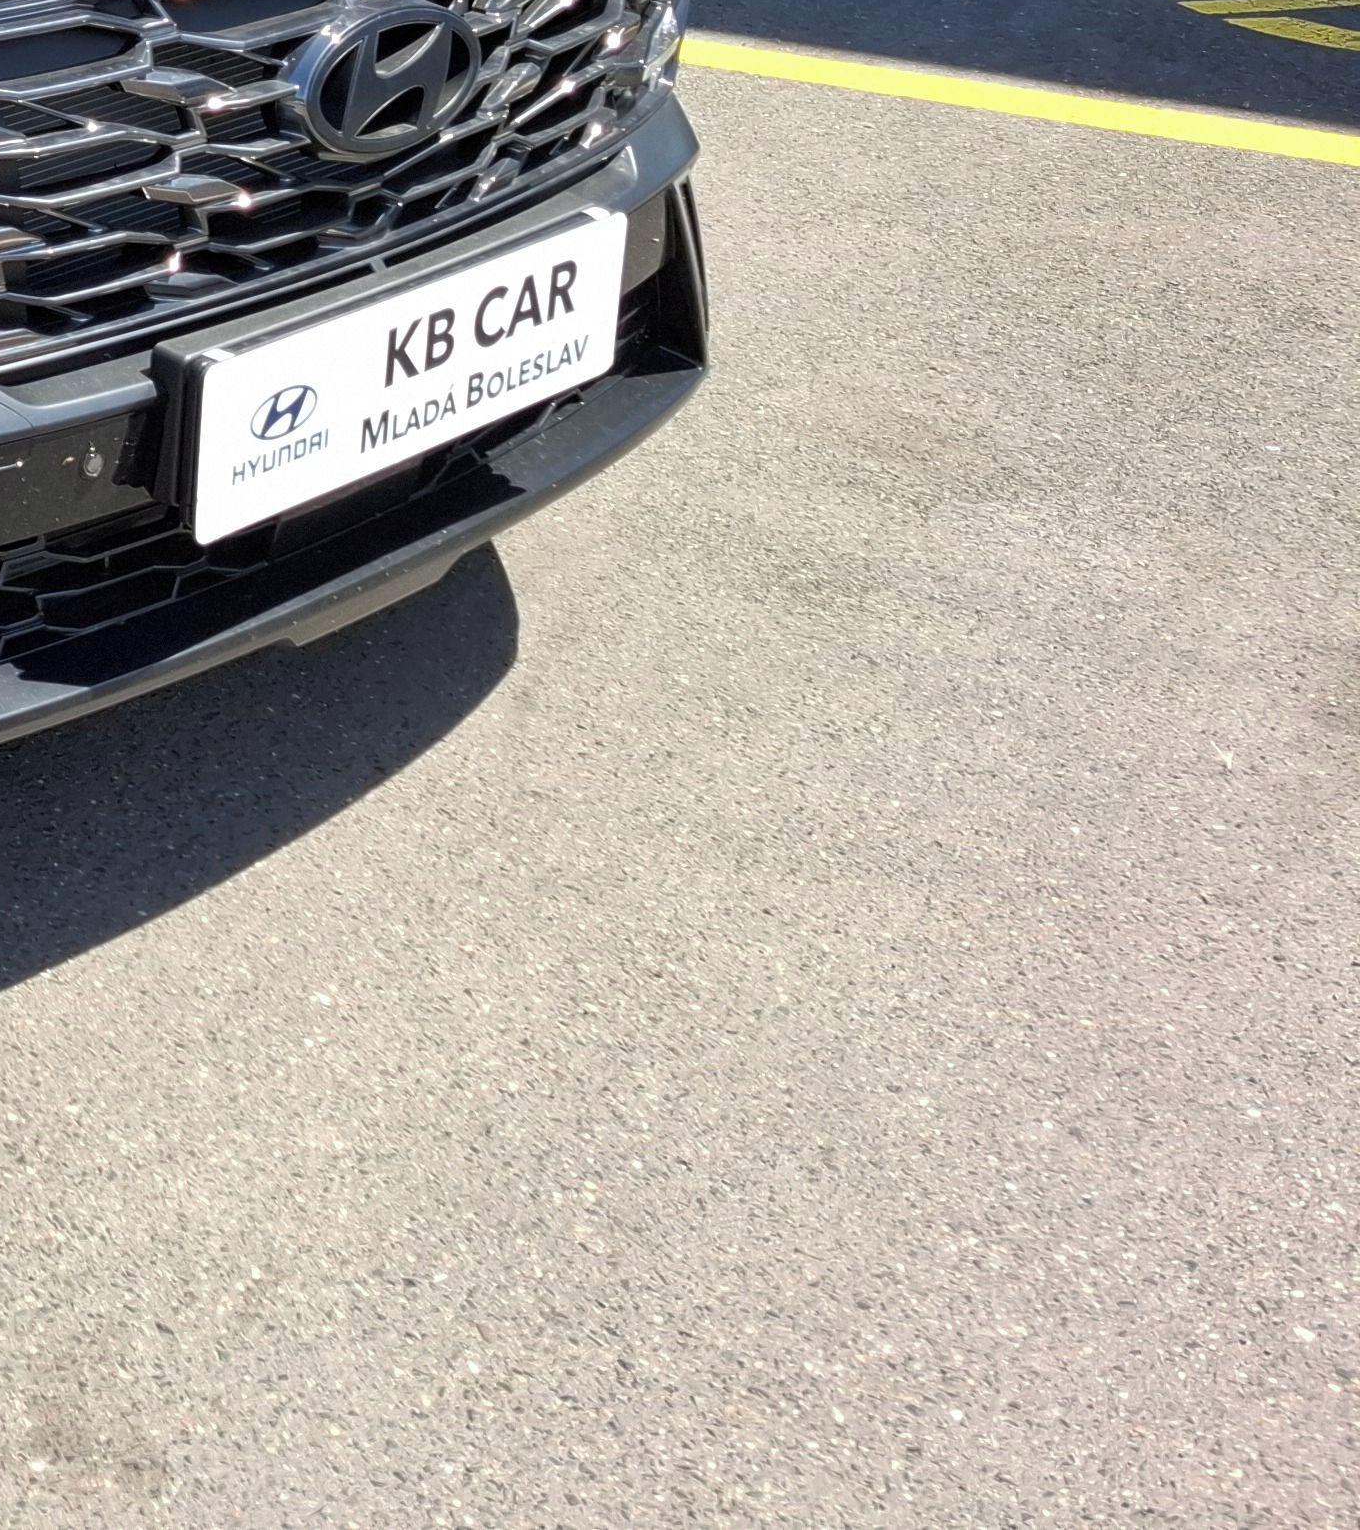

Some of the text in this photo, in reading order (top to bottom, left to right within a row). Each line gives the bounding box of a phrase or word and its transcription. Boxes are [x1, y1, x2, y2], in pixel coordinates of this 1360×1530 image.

[384, 259, 578, 389] KB CAR
[465, 334, 591, 410] BOLESLAV
[231, 427, 330, 486] HYUNDAI
